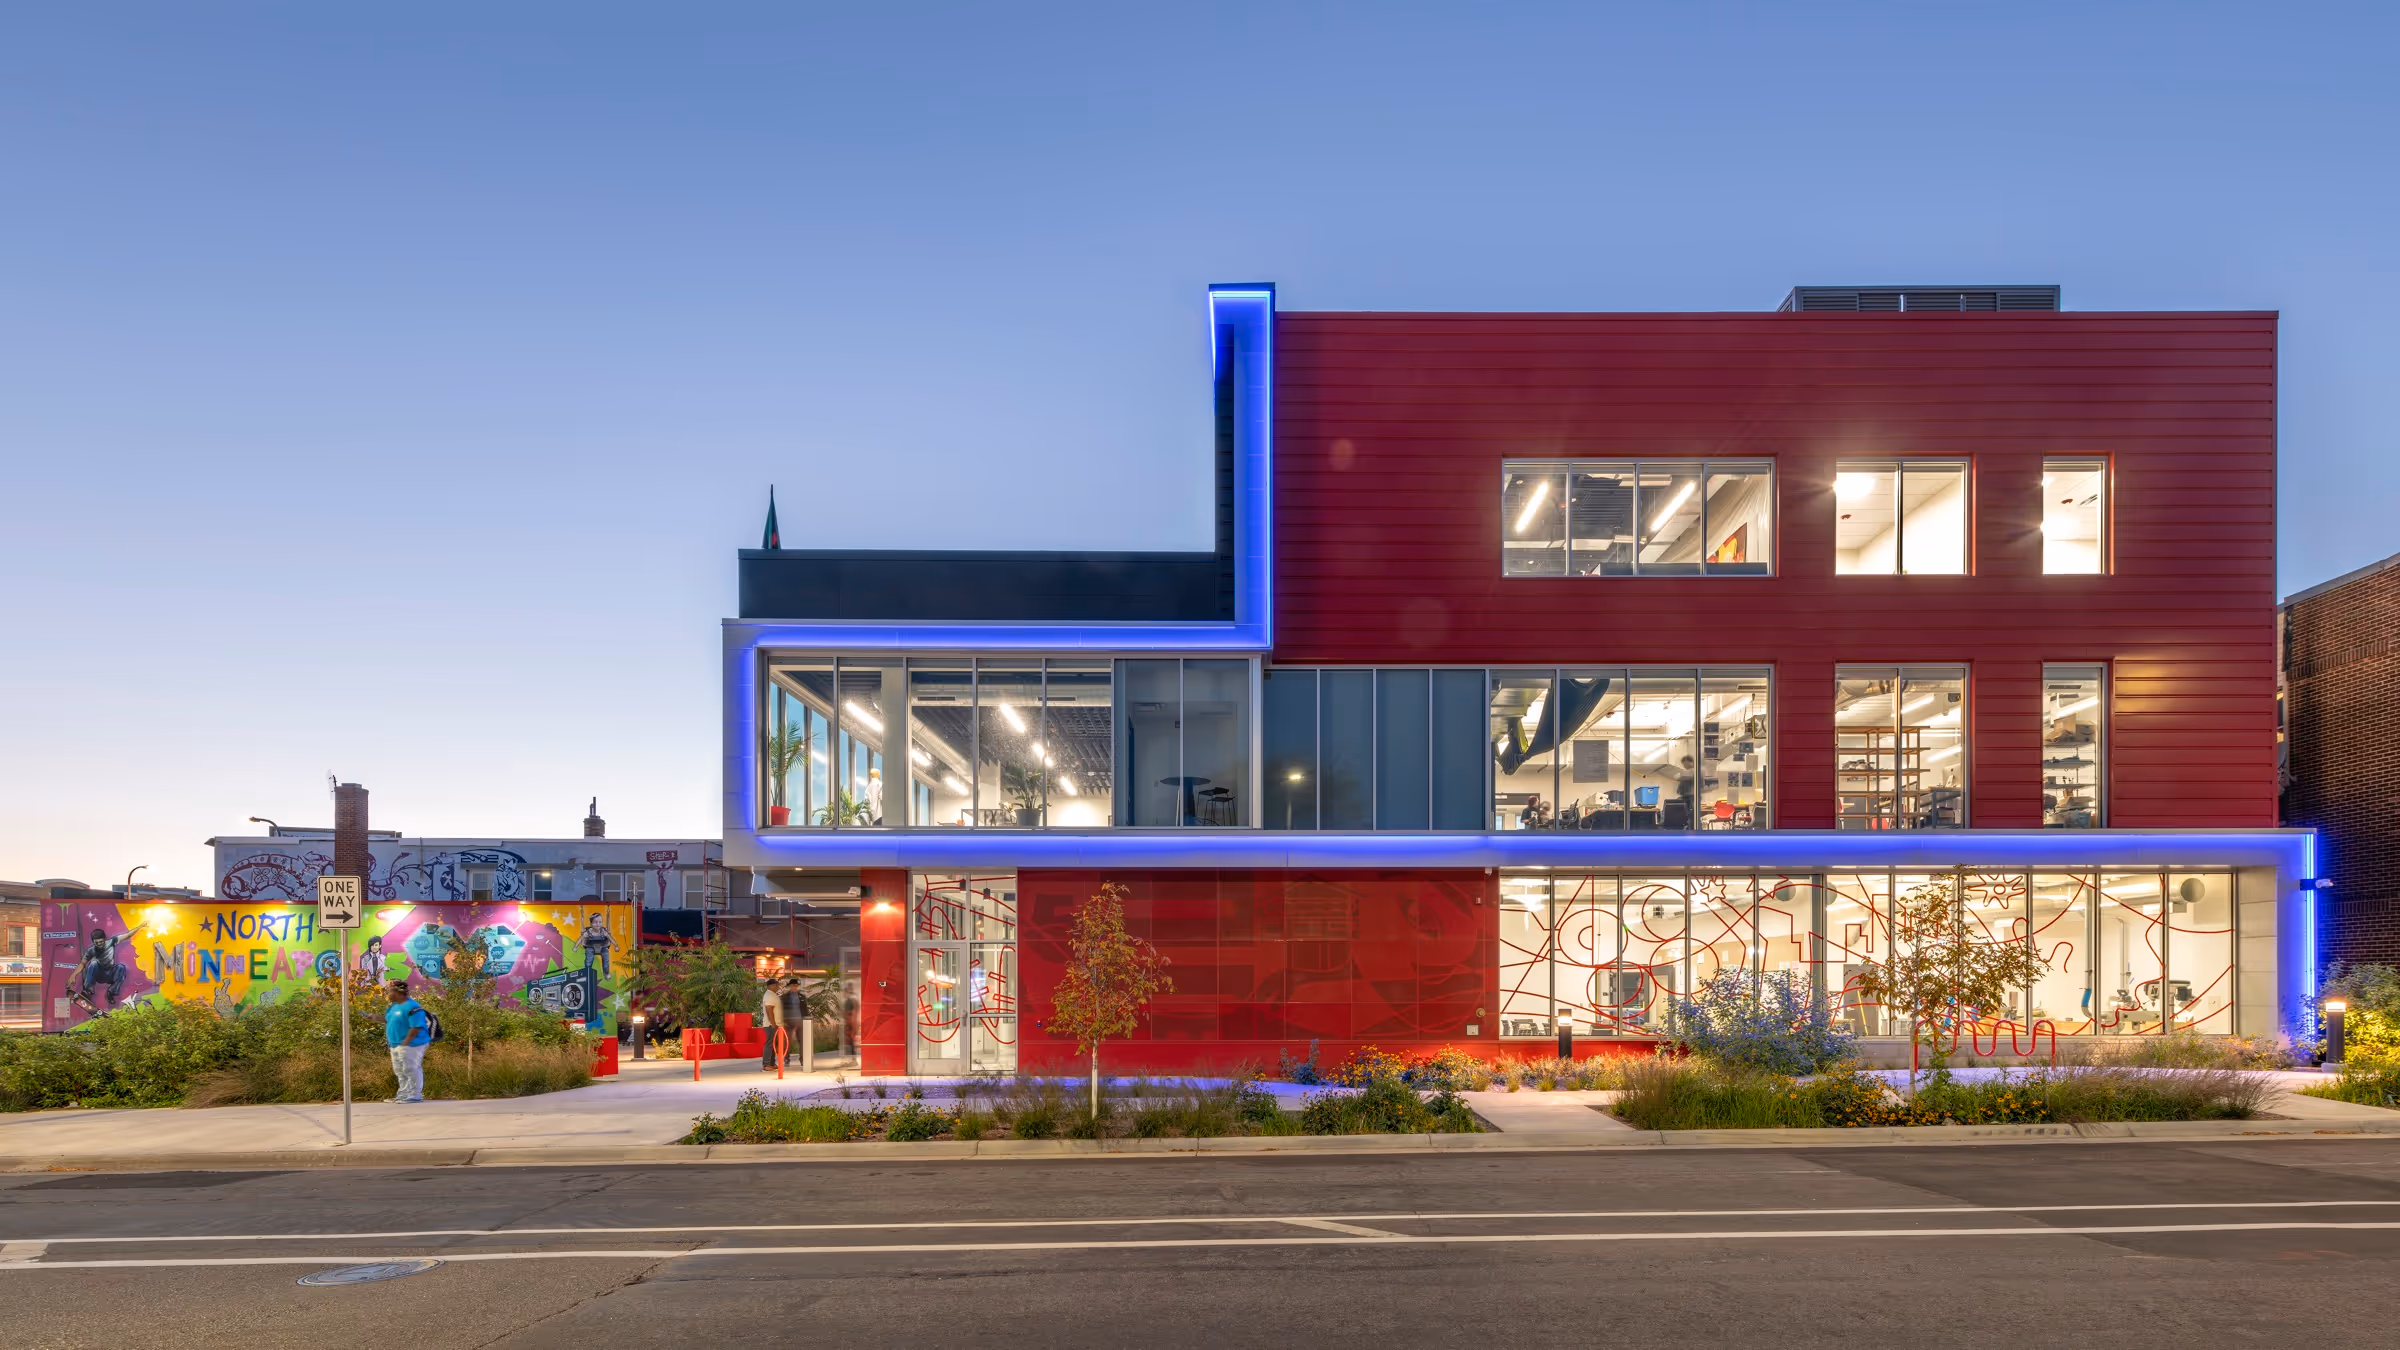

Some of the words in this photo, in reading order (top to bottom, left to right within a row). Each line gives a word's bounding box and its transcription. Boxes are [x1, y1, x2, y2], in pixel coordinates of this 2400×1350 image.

[325, 881, 354, 893] ONE
[324, 895, 355, 907] WAY
[215, 910, 315, 944] NORTH
